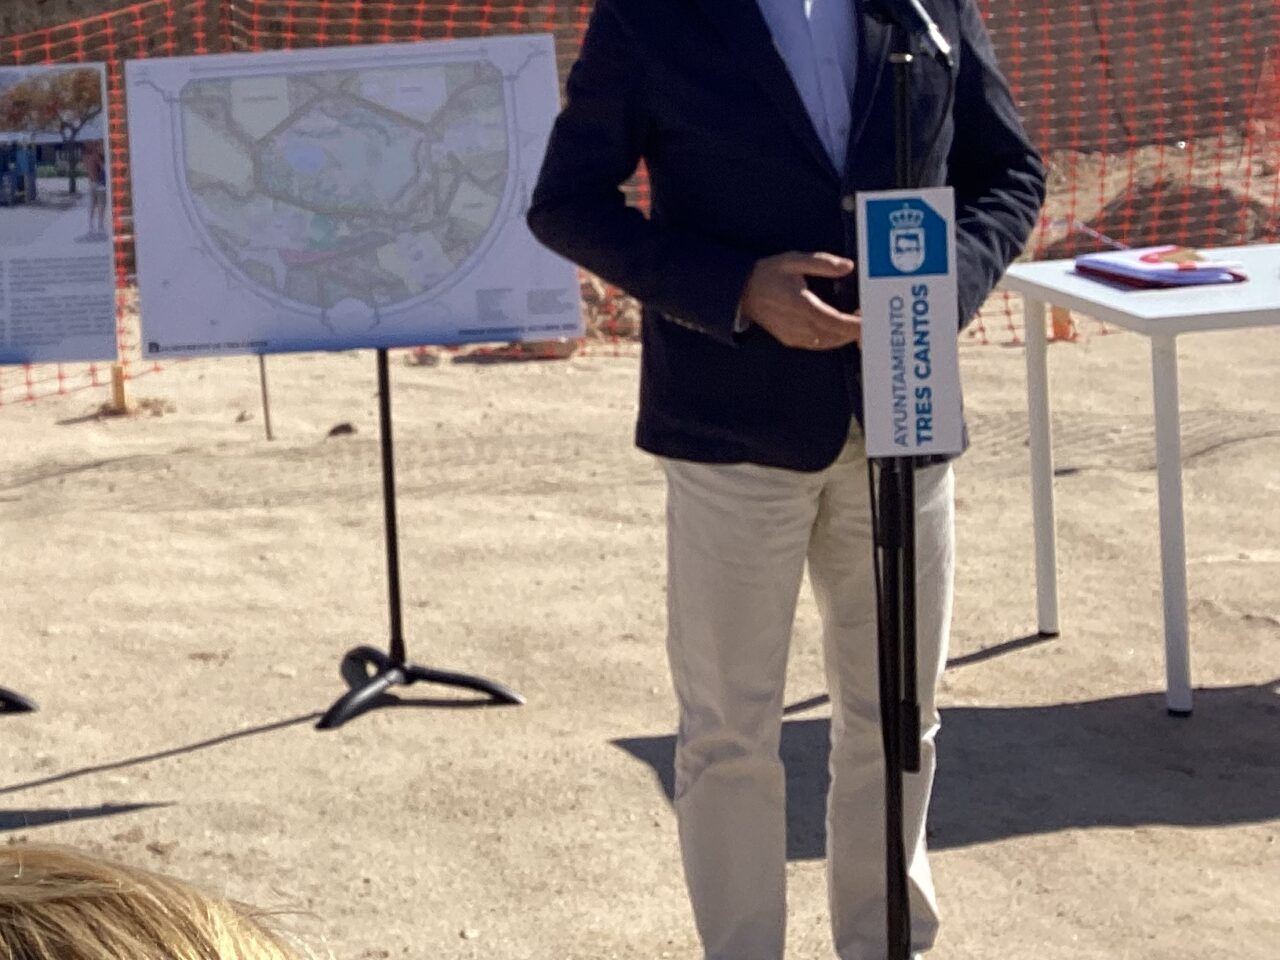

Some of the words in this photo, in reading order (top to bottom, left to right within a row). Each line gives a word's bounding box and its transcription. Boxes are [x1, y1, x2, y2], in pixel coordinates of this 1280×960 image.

[889, 296, 909, 447] AYUNTAMIENTO
[911, 284, 932, 380] CANTOS
[915, 385, 934, 446] TRES
